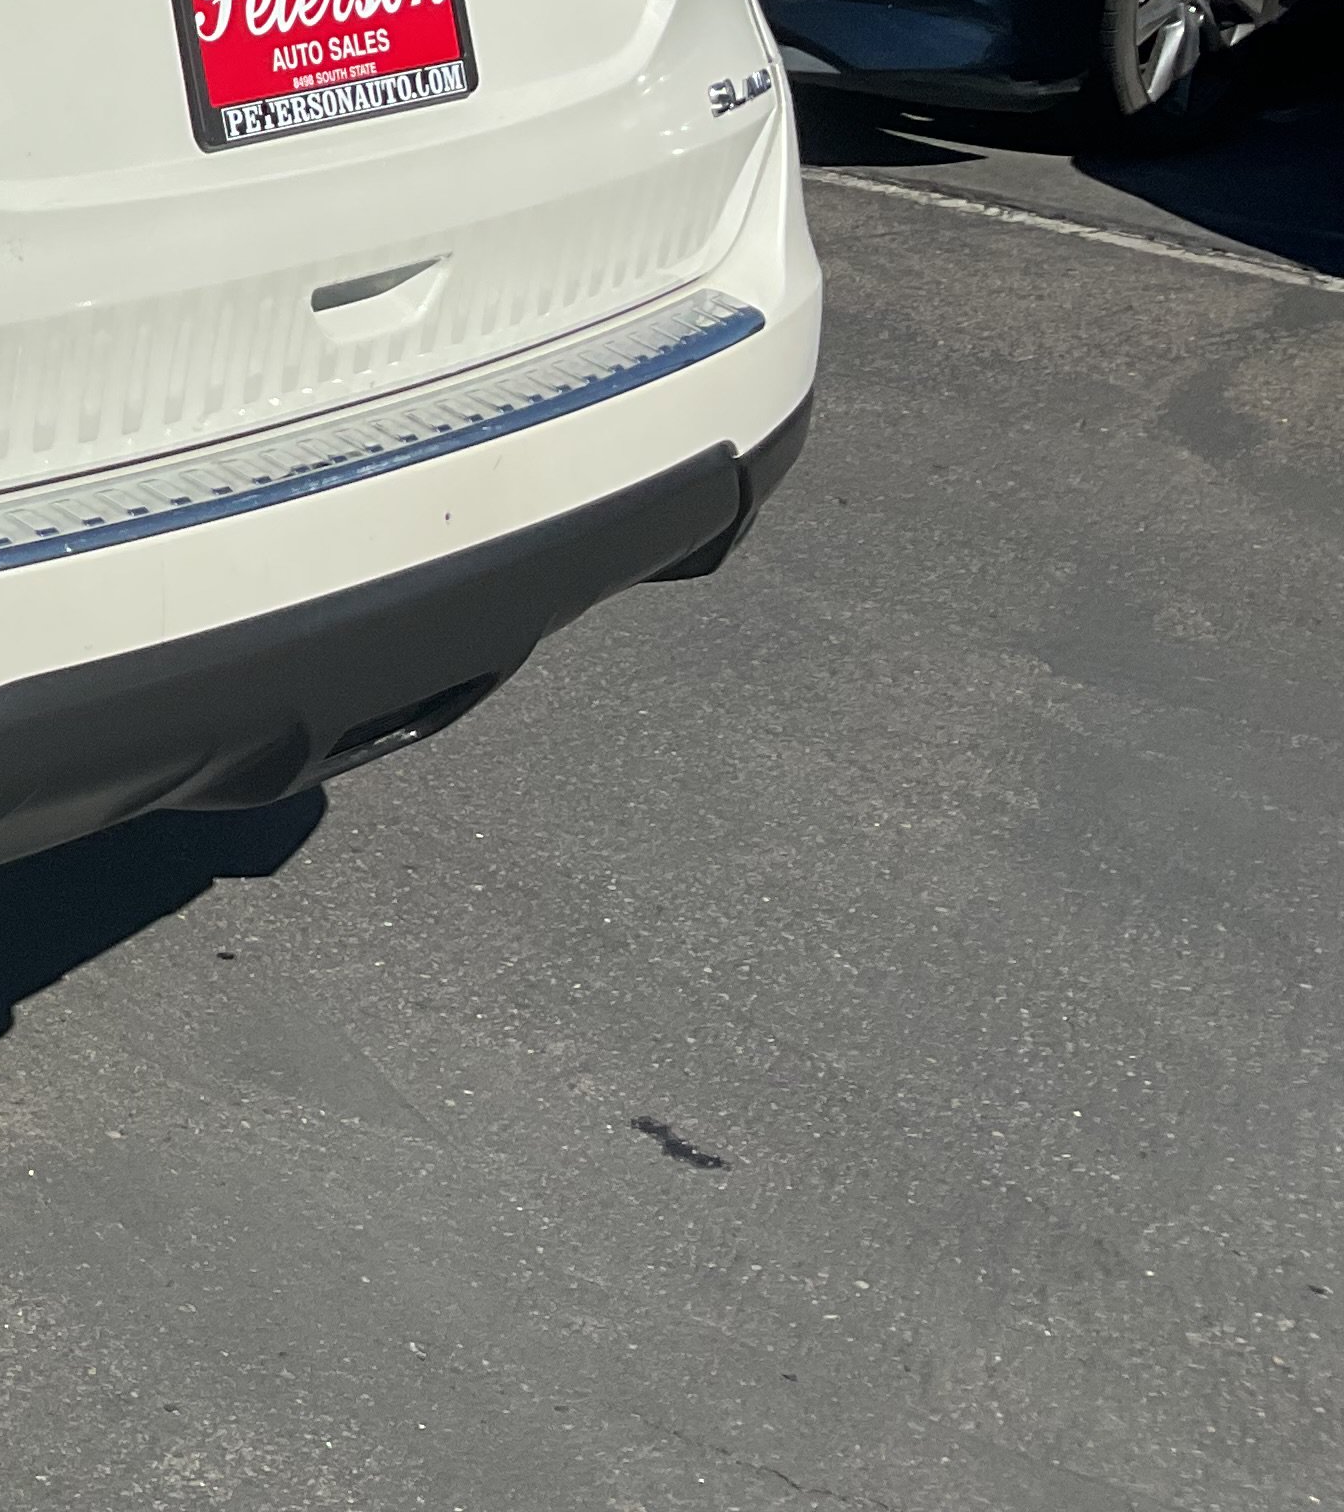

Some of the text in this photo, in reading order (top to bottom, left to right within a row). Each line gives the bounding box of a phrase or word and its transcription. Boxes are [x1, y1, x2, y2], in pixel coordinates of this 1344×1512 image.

[272, 28, 391, 72] AUTO SALES
[293, 61, 378, 89] 8498 SOUTH STATE
[225, 62, 464, 137] PETERSONAUTO.COM
